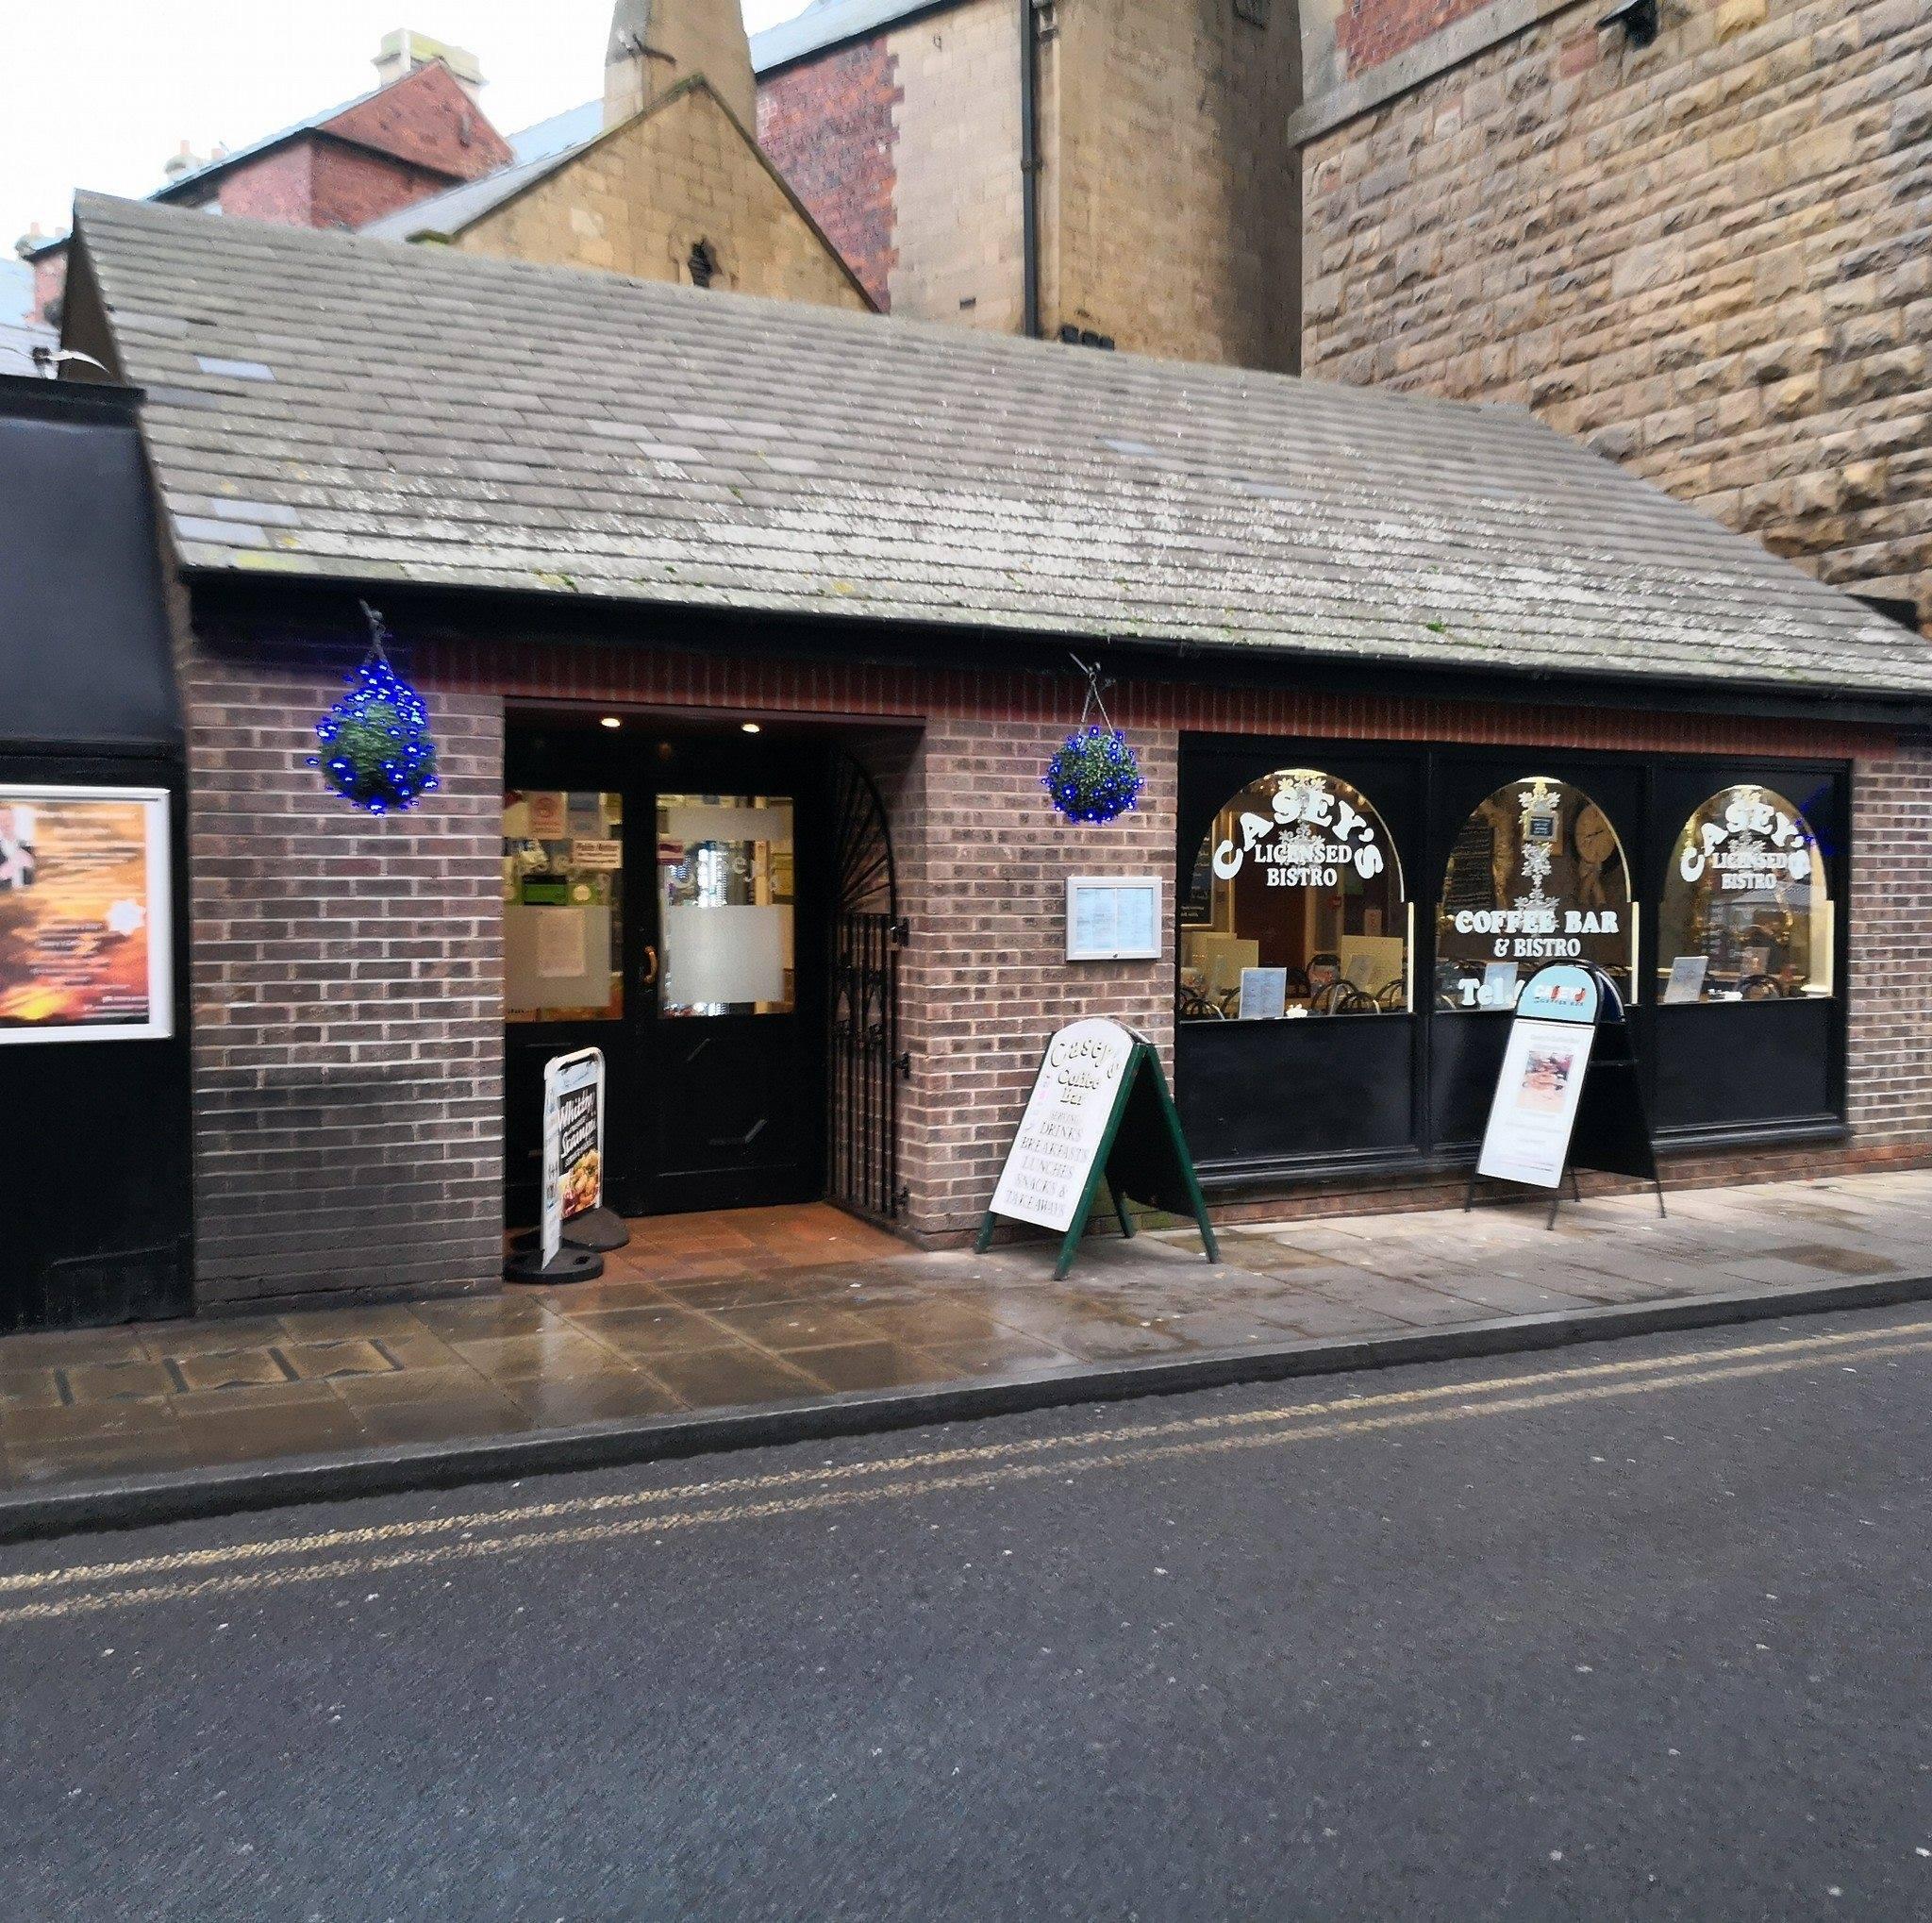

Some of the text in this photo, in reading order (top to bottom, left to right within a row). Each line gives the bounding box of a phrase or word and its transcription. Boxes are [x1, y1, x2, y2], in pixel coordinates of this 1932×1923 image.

[1213, 789, 1384, 879] CASEY'S
[1266, 867, 1338, 886] BISTRO
[1722, 873, 1777, 889] BISTRO
[1455, 911, 1620, 933] COFFEE BAR
[1493, 938, 1581, 957] & BISTRO
[1040, 1122, 1082, 1143] DRINKS
